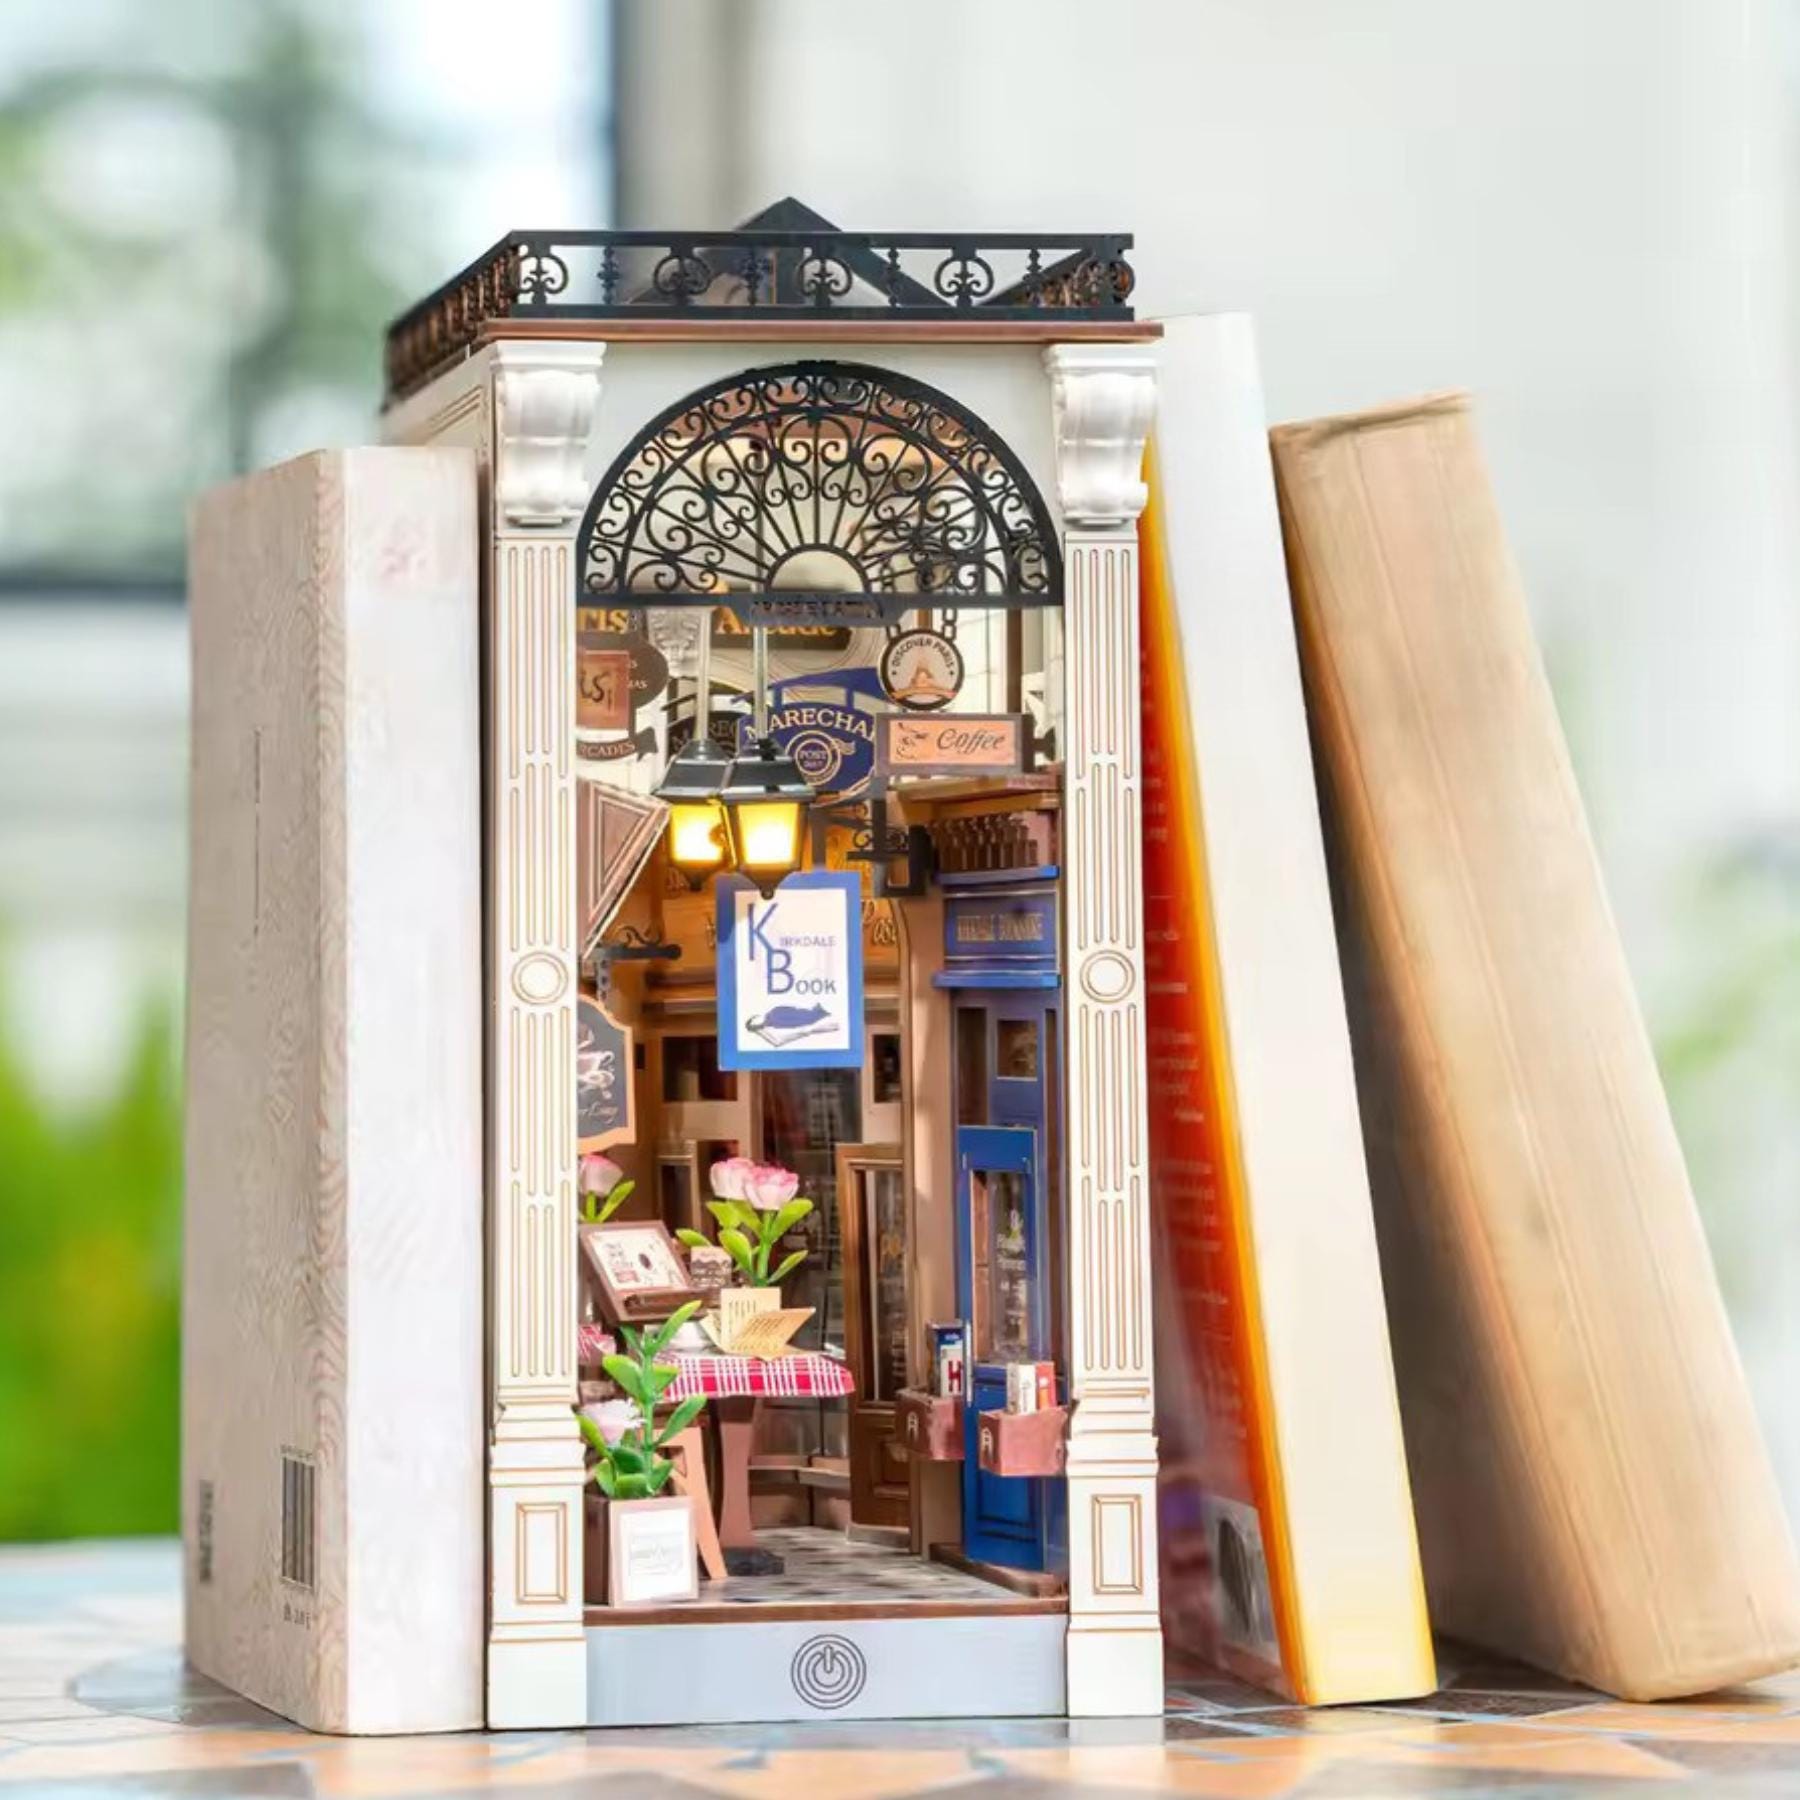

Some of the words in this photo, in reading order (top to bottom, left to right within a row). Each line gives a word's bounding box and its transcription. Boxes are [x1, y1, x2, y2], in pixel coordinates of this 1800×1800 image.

[891, 636, 932, 667] DISCOVER
[933, 642, 955, 668] PARIS
[937, 728, 1006, 754] Coffee
